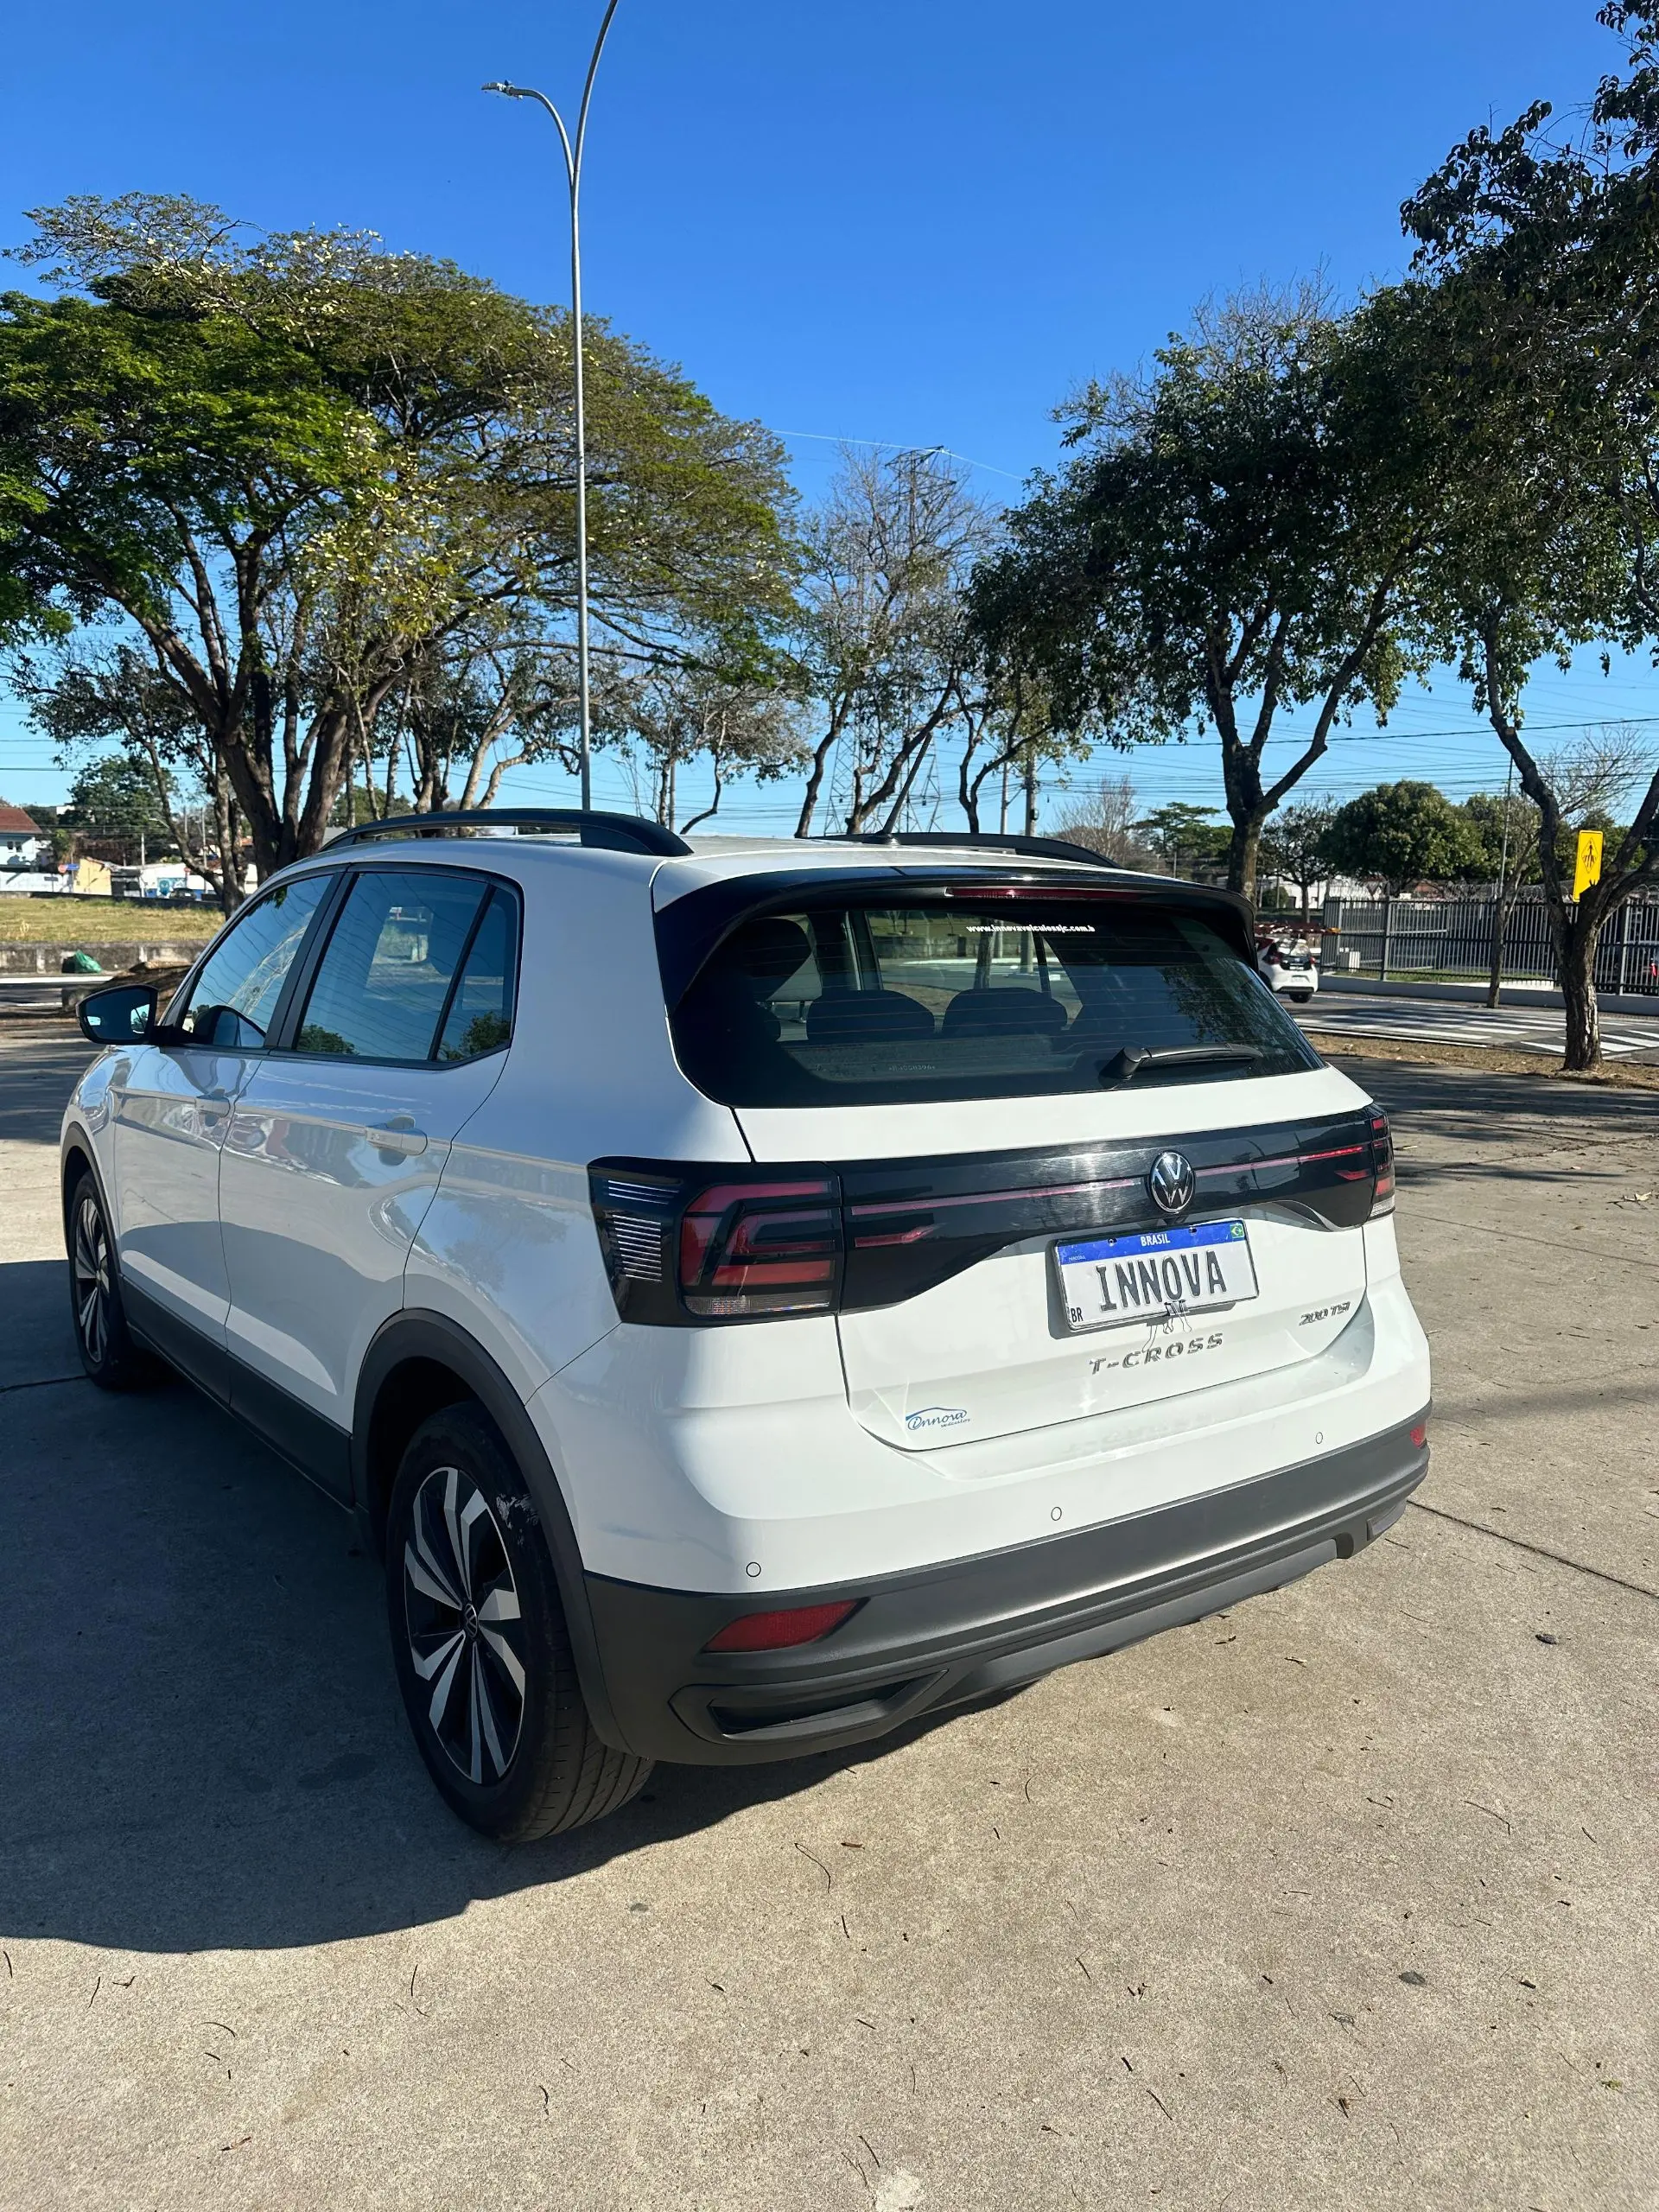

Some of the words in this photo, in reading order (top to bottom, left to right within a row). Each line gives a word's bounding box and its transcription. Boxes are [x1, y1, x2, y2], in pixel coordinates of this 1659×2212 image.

[1140, 1233, 1171, 1247] BRASIL
[1096, 1250, 1226, 1312] INNOVA
[1071, 1306, 1084, 1323] BR
[1089, 1332, 1224, 1375] T-CROSS
